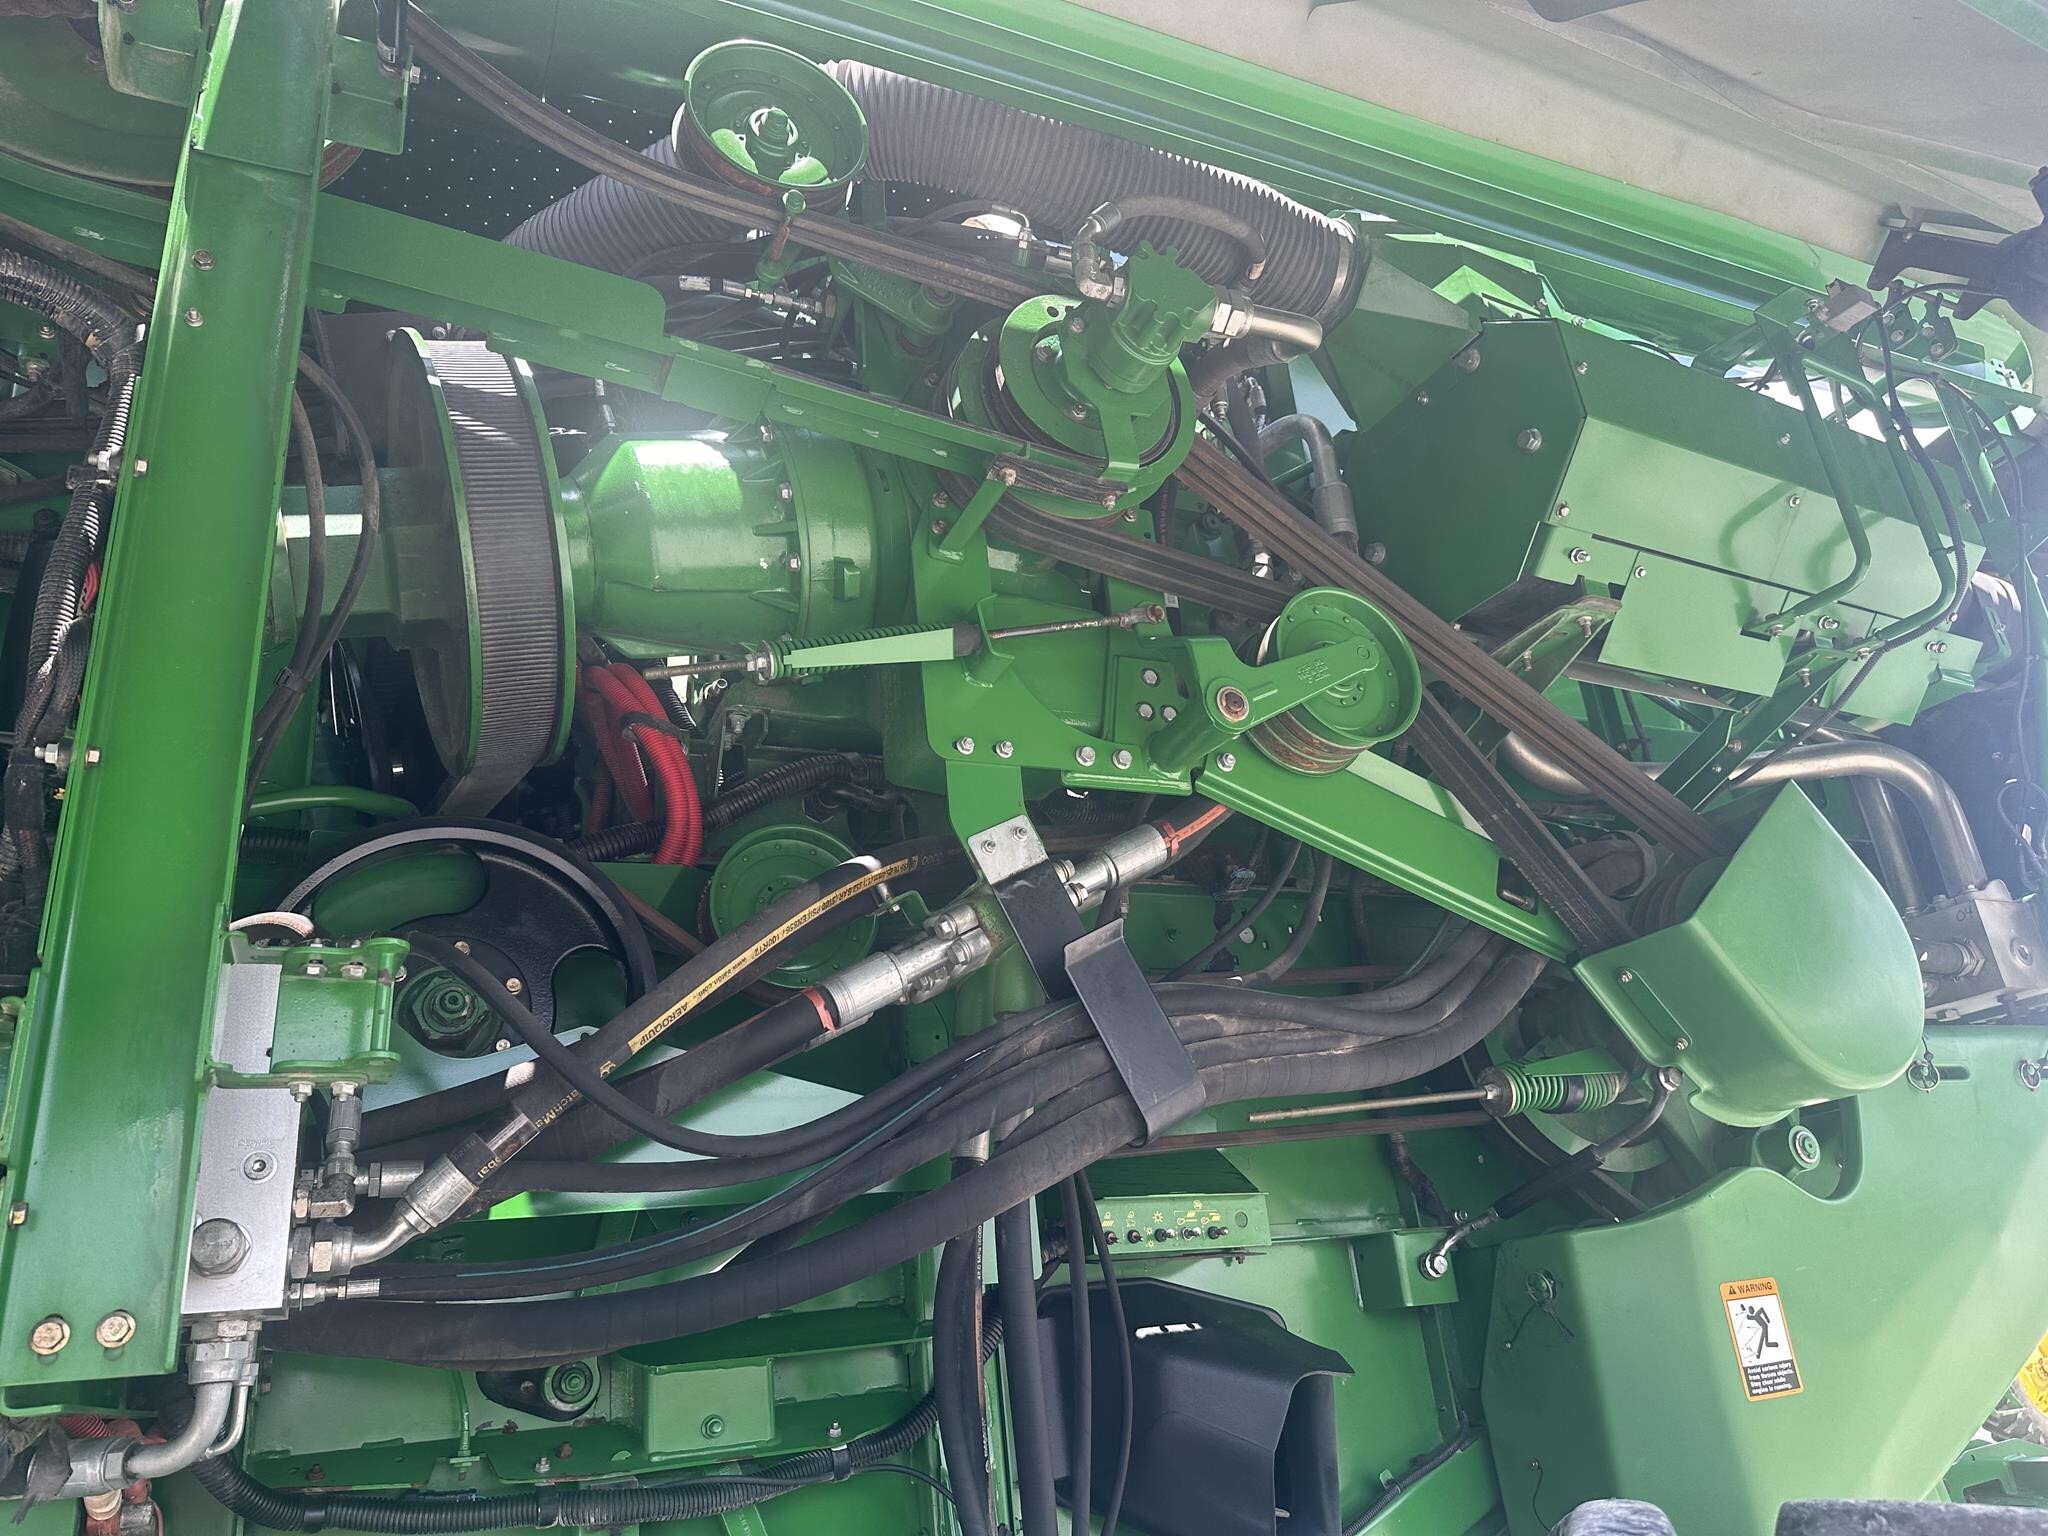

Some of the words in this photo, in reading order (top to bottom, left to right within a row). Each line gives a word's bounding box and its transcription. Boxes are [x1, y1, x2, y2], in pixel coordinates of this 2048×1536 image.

[640, 1001, 688, 1046] AEROQUIP
[1737, 1281, 1773, 1294] WARNING
[1748, 1366, 1761, 1374] Avoid
[1761, 1364, 1778, 1372] serious
